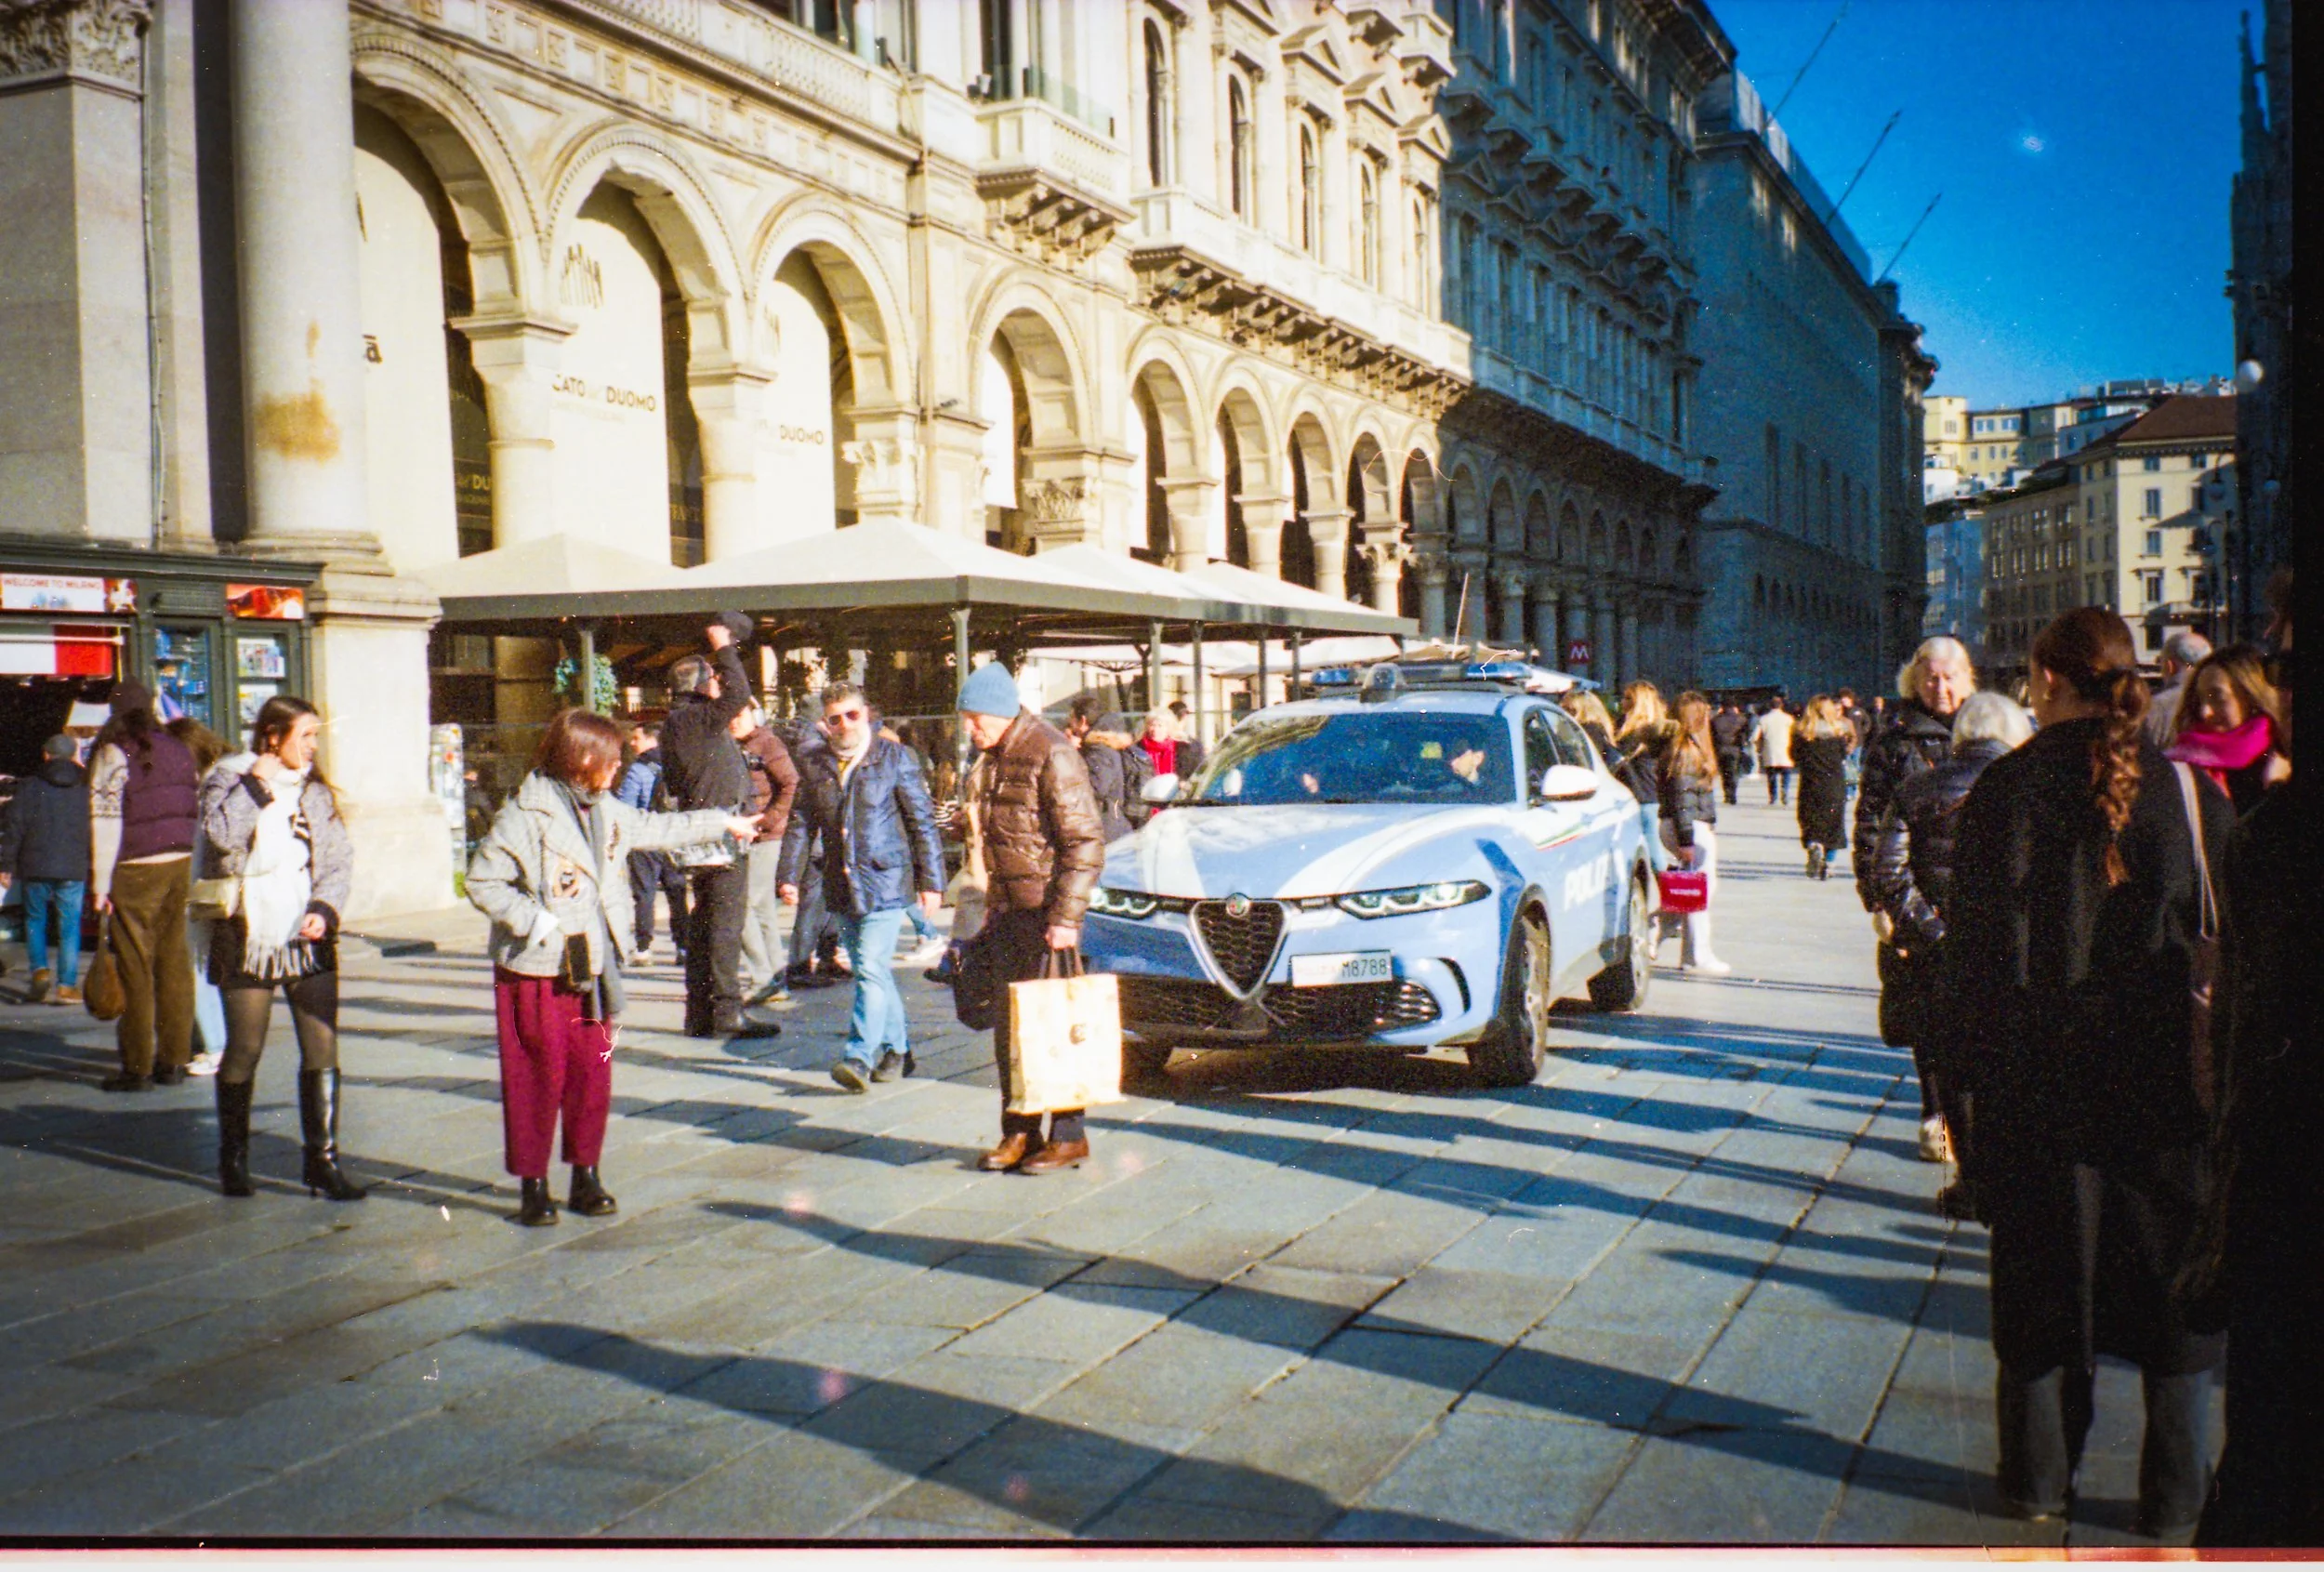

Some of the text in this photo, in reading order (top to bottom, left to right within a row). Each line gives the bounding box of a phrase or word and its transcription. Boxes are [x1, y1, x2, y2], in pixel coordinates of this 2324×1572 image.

[605, 384, 656, 412] DUOMO
[779, 424, 824, 445] DUOMO
[5, 576, 49, 588] WELCOME
[66, 579, 101, 589] MILANO
[1570, 645, 1590, 660] M
[1340, 958, 1388, 979] M8788
